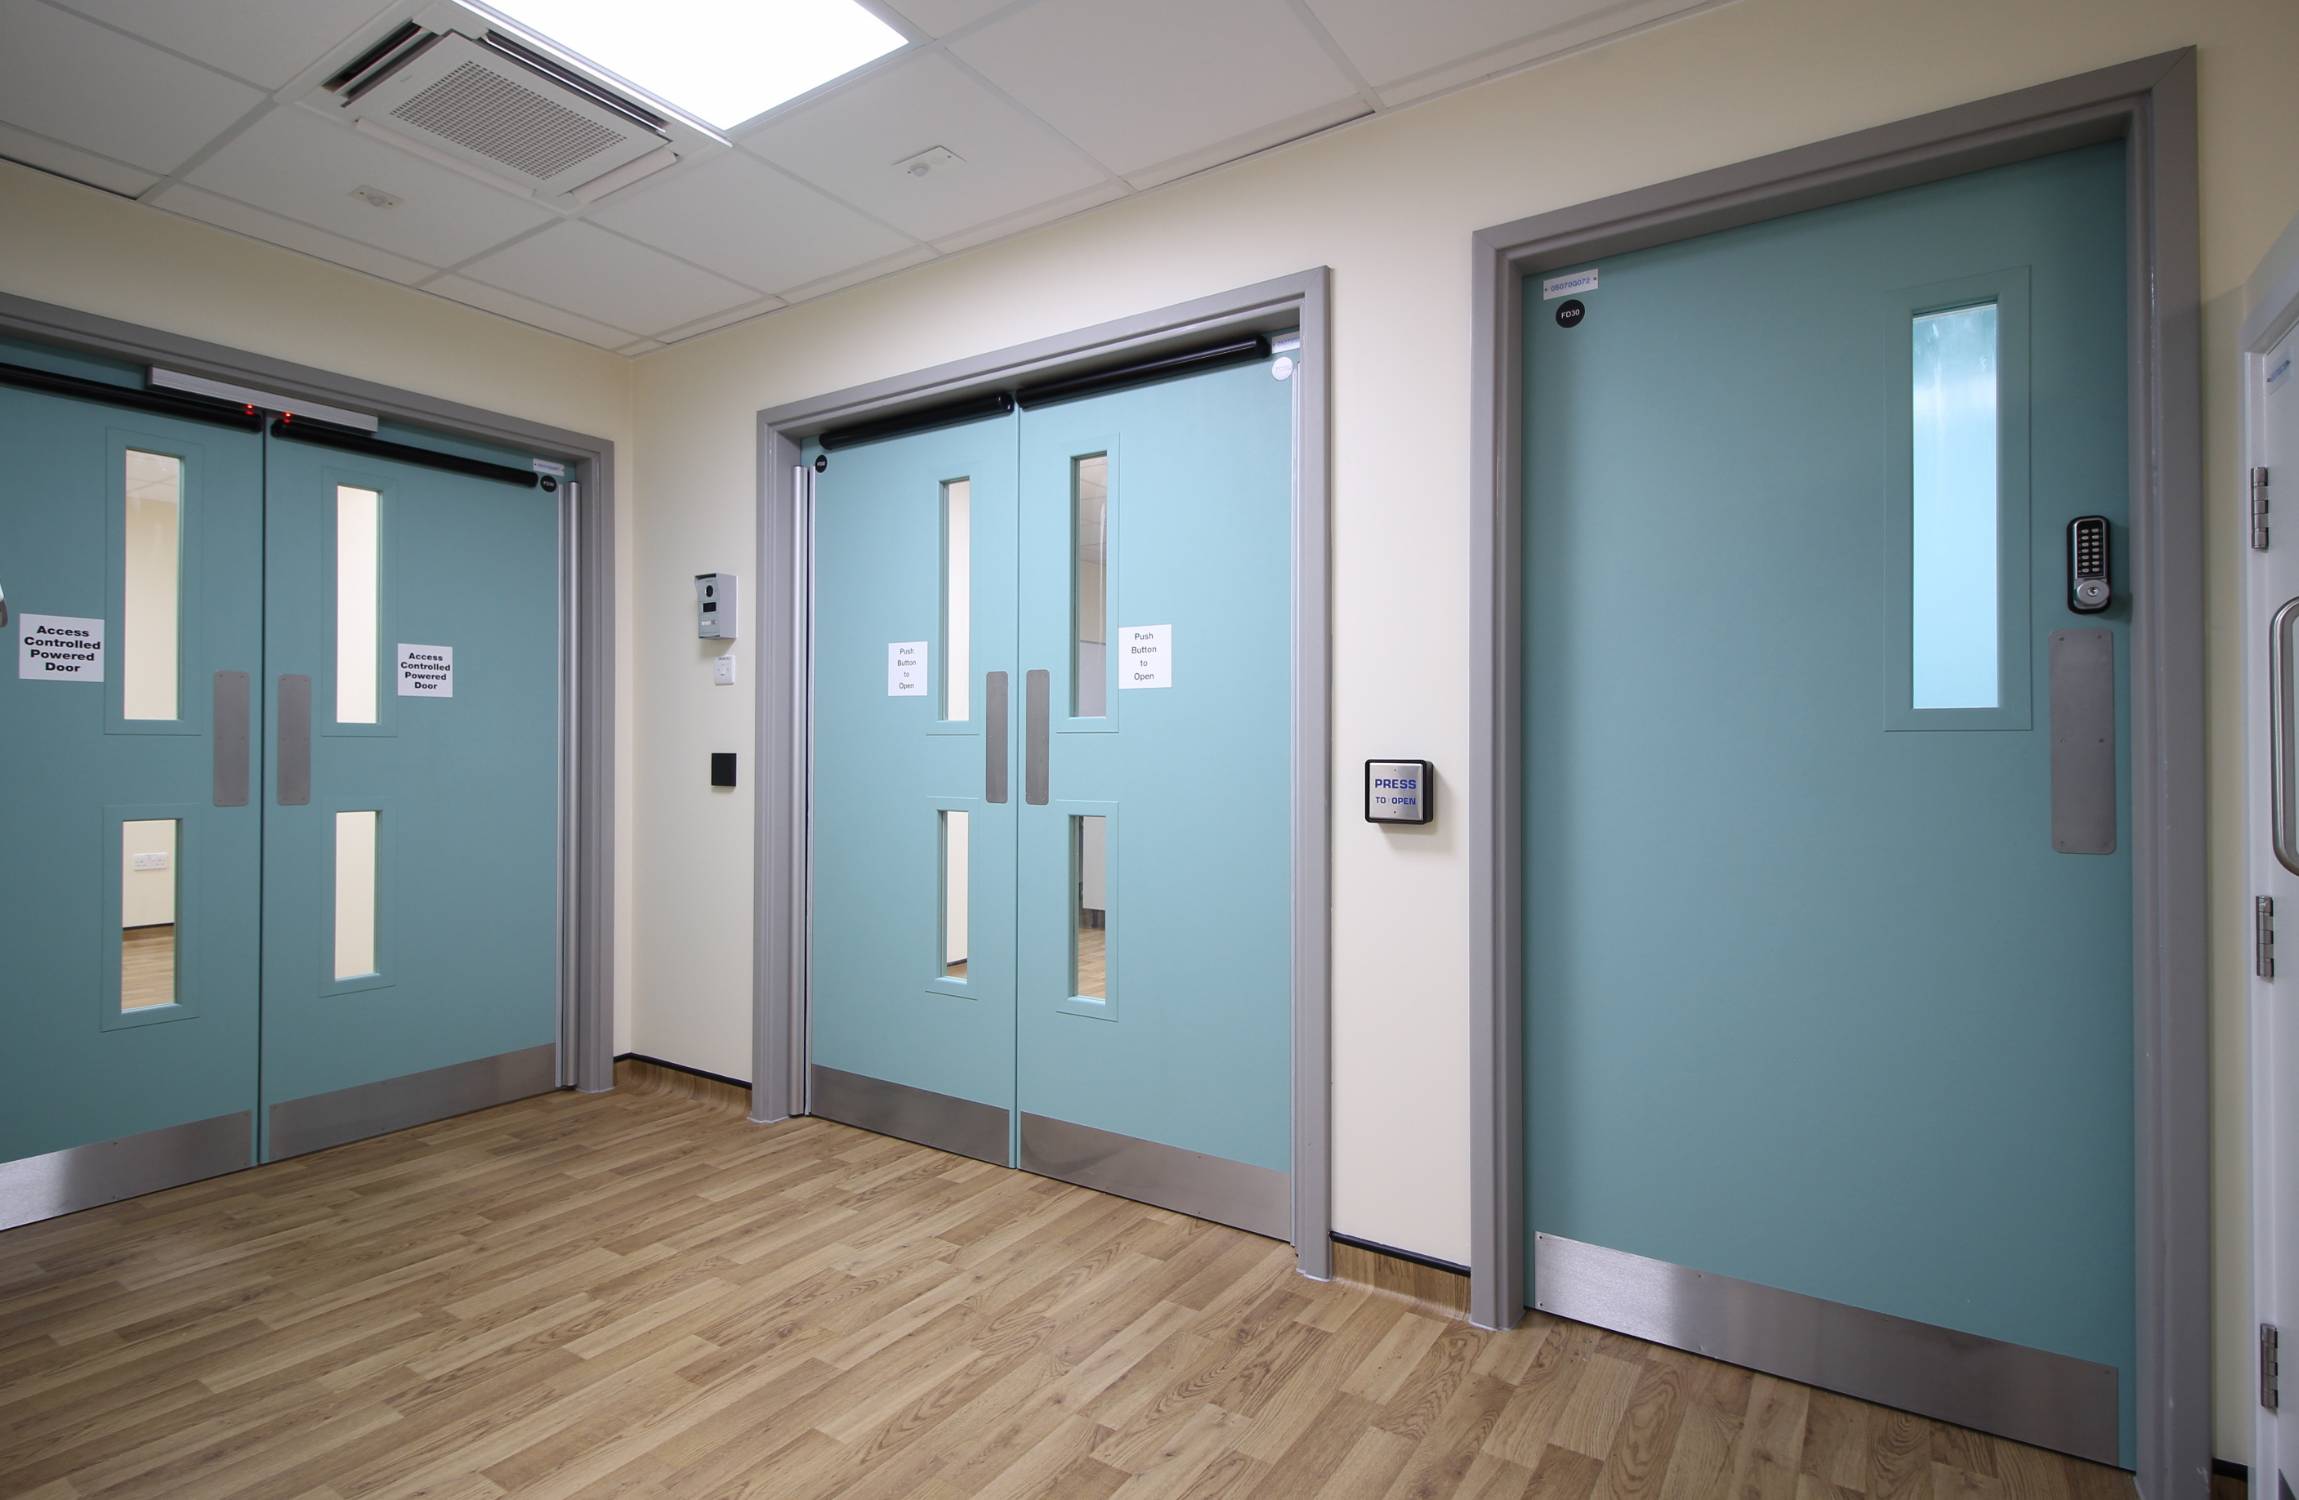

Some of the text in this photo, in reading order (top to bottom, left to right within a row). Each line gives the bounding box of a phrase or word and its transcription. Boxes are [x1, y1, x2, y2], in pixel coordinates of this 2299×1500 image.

[1561, 308, 1580, 319] FD30
[36, 625, 90, 637] Access
[1134, 632, 1154, 640] Push
[24, 636, 101, 650] Controlled
[1131, 646, 1157, 654] Button
[30, 649, 95, 661] Powered
[409, 652, 443, 661] Access
[45, 662, 81, 672] Door
[400, 661, 451, 671] Controlled
[405, 671, 447, 680] Powered
[1134, 672, 1155, 681] Open
[414, 681, 438, 689] Door
[1375, 778, 1417, 789] PRESS
[1376, 796, 1416, 805] TO OPEN
